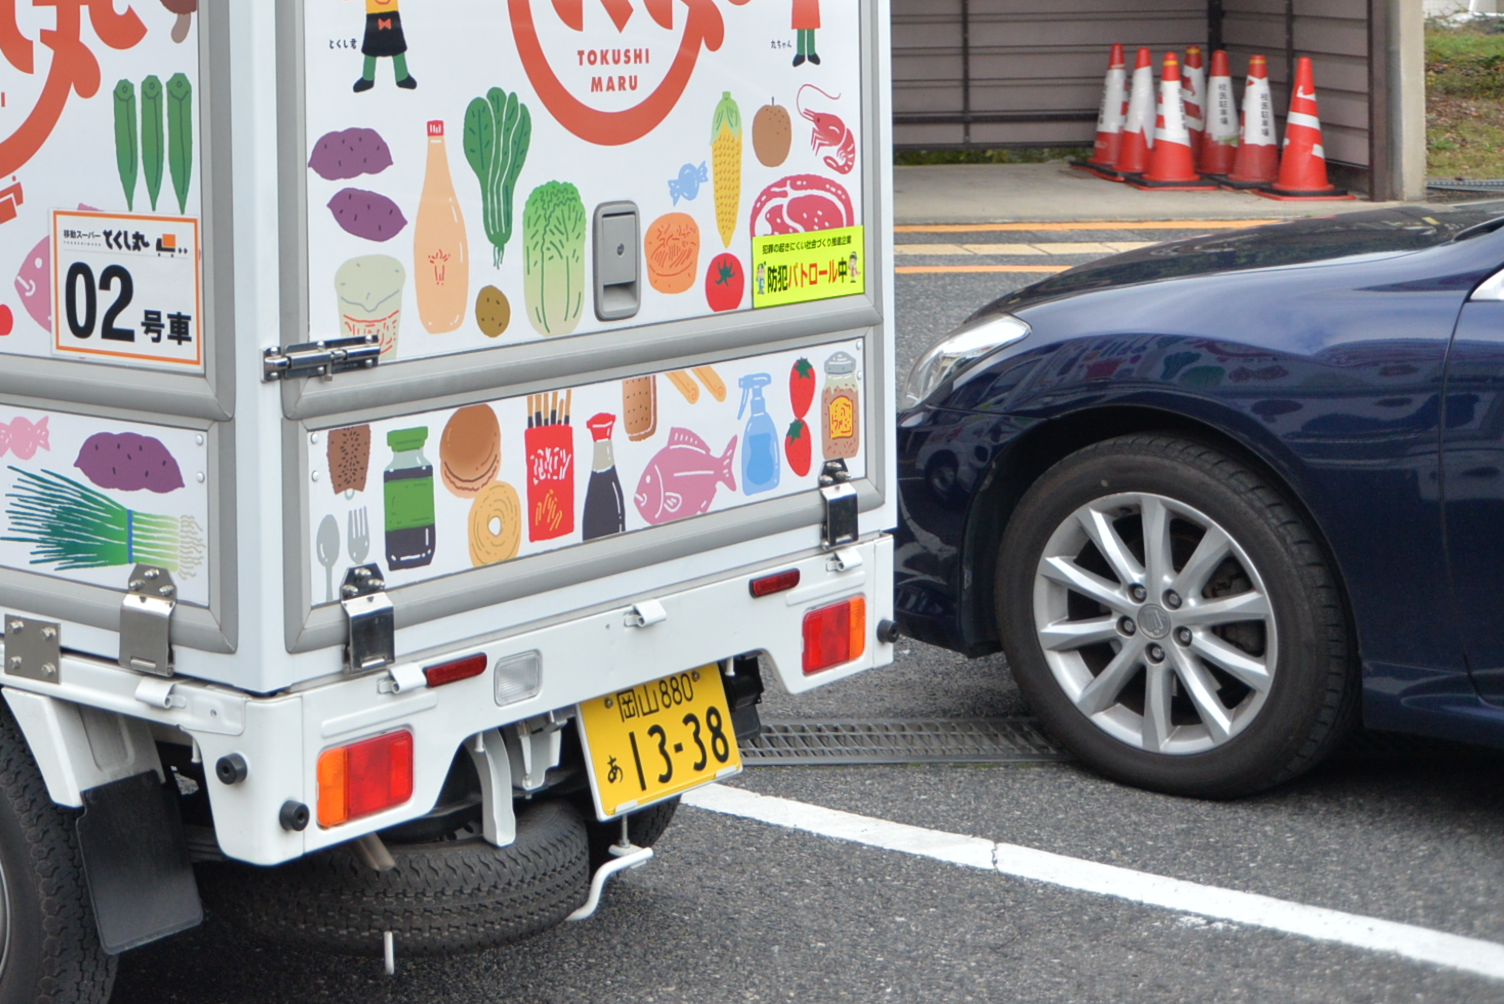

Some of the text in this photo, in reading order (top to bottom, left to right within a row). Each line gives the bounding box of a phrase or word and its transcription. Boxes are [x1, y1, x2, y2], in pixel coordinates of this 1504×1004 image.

[329, 38, 357, 50] とくし君
[770, 39, 792, 50] 丸ちゃん
[577, 49, 650, 66] TOKUSHI
[590, 75, 639, 92] MARU
[63, 229, 150, 252] 移動スーパー とくし丸
[767, 257, 847, 293] 防犯パトロール中
[607, 706, 729, 791] あ 13-38
